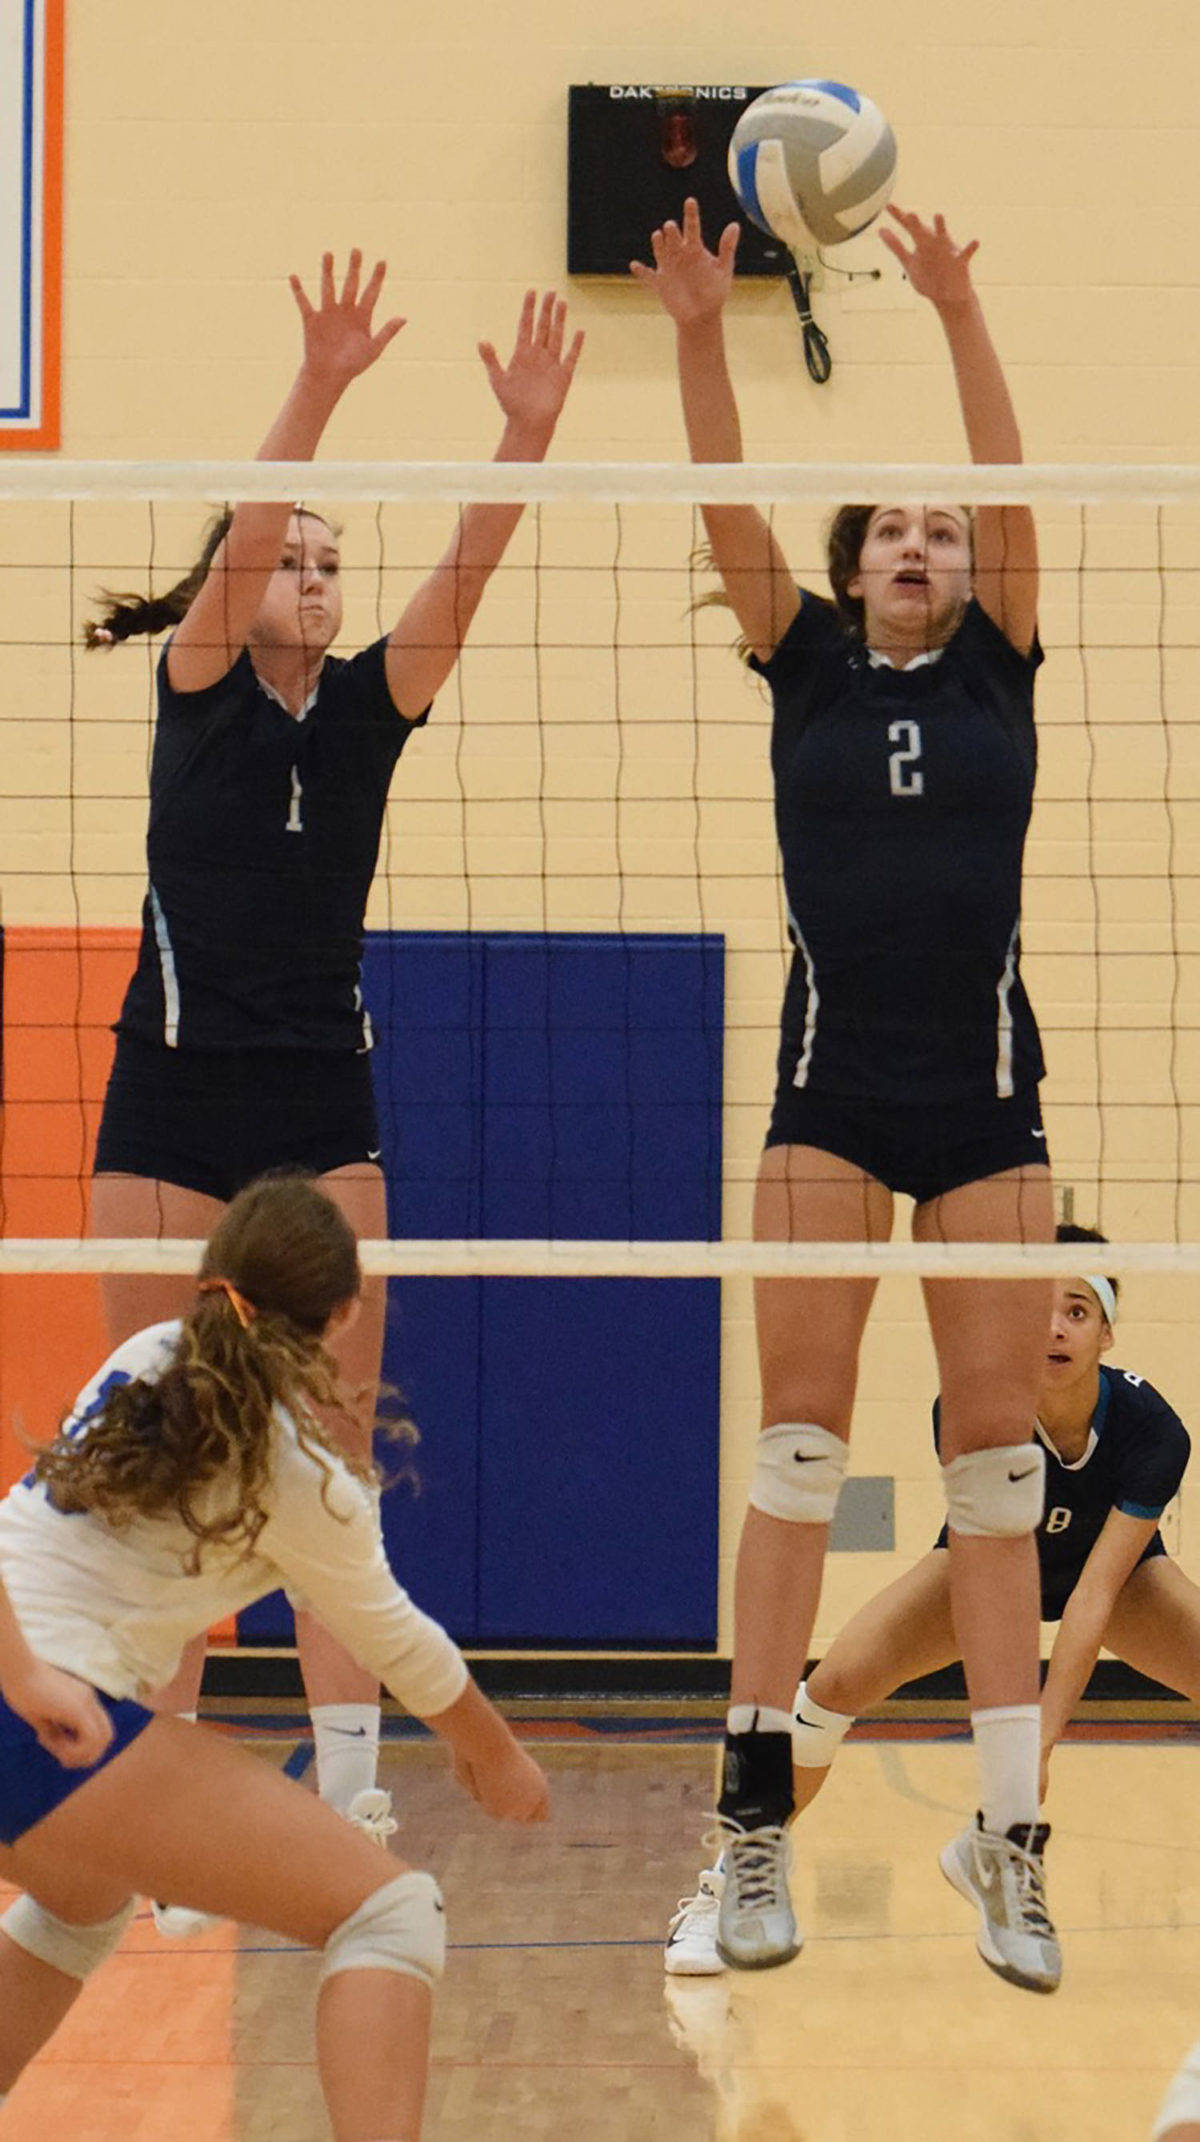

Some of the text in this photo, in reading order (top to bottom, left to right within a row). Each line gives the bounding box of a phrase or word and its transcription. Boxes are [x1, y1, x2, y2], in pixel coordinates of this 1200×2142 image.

[609, 85, 748, 100] DAKNICS
[888, 720, 923, 796] 2
[285, 764, 303, 832] 1
[1046, 1506, 1072, 1534] 8
